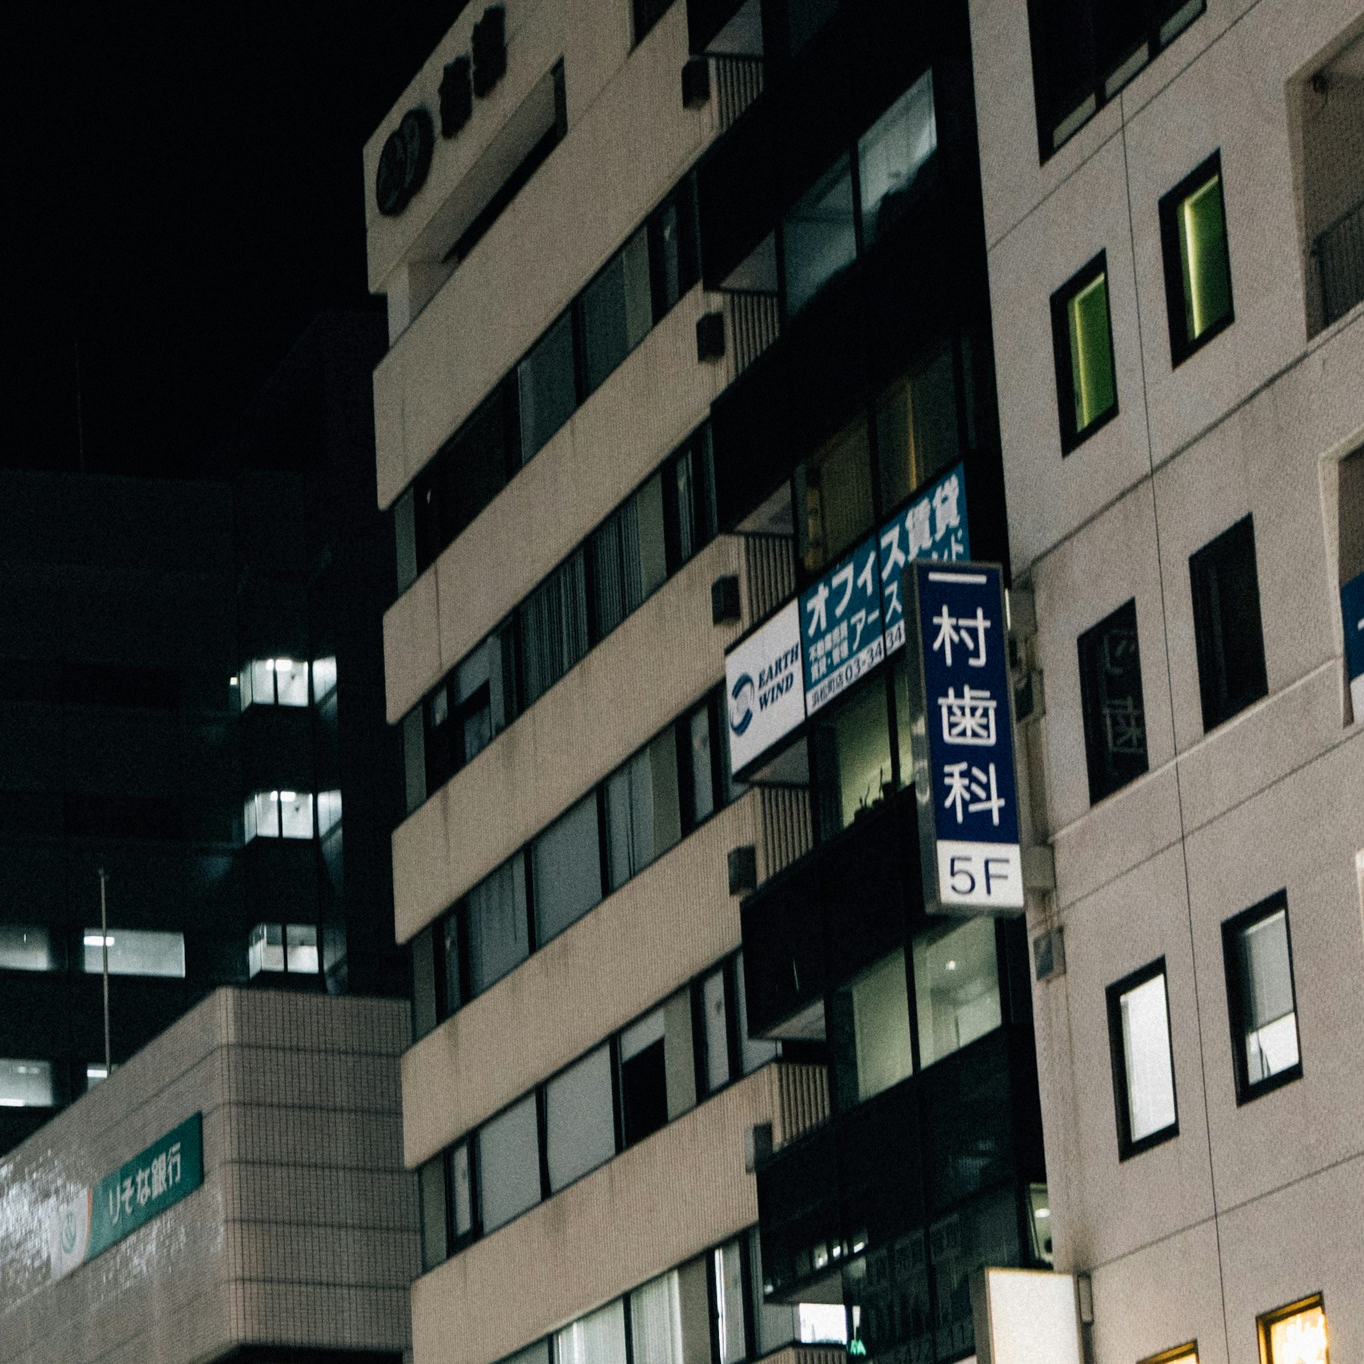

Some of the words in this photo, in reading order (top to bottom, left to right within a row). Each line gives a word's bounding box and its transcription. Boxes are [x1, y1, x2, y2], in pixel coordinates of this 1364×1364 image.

[806, 473, 961, 638] オフィス賃貸
[758, 640, 800, 692] EARTH
[758, 673, 795, 712] WIND
[927, 571, 1006, 827] 一村歯科
[949, 855, 1010, 897] 5F
[109, 1141, 182, 1227] りそな銀行
